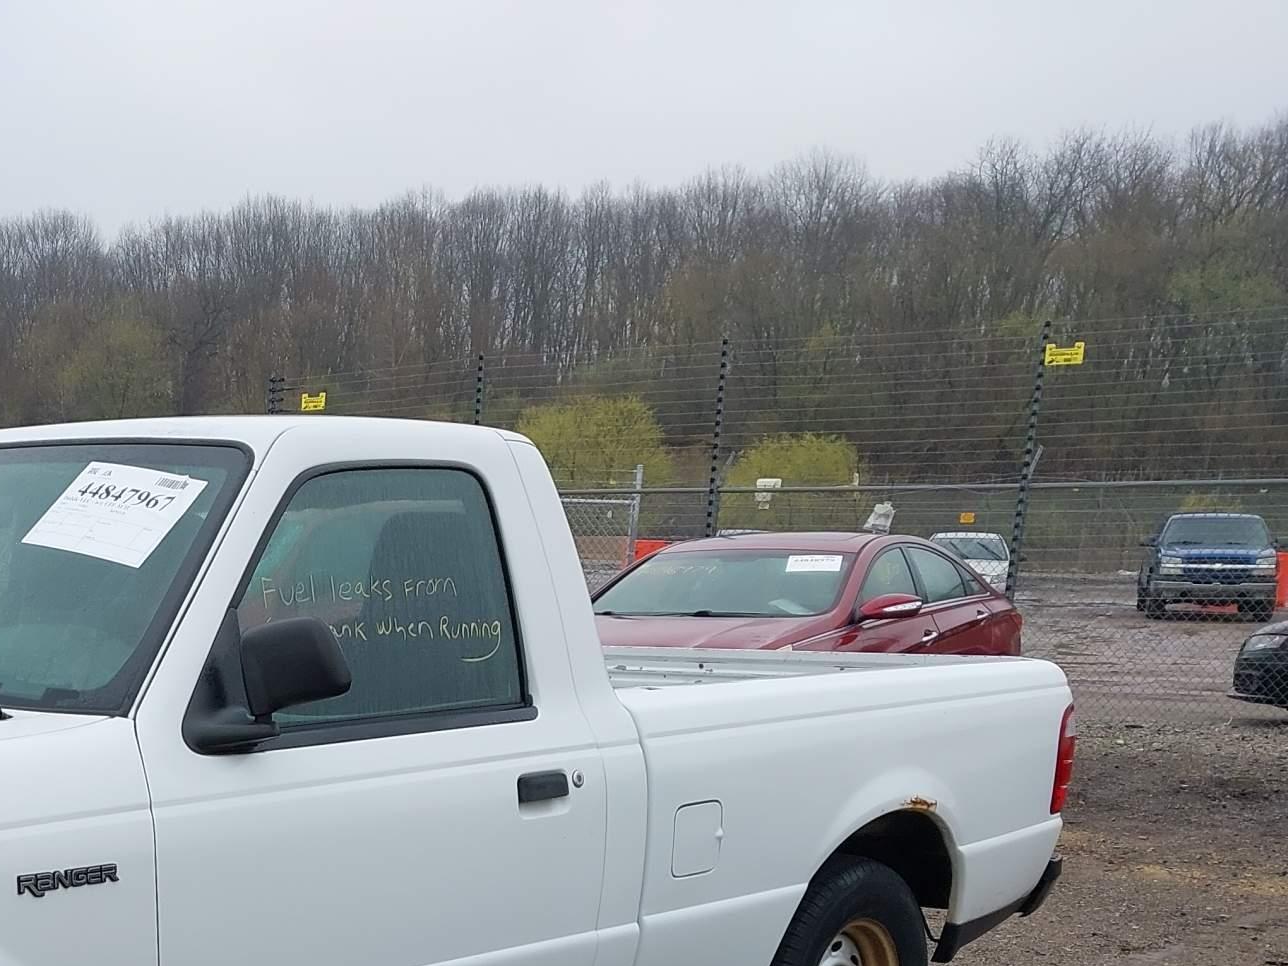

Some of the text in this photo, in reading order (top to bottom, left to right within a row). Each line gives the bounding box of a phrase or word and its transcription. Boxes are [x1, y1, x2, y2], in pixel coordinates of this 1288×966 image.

[78, 481, 177, 512] 44847967
[262, 575, 316, 608] Fuel
[330, 575, 394, 601] leaks
[440, 615, 502, 662] Running
[17, 863, 120, 897] RANGER
